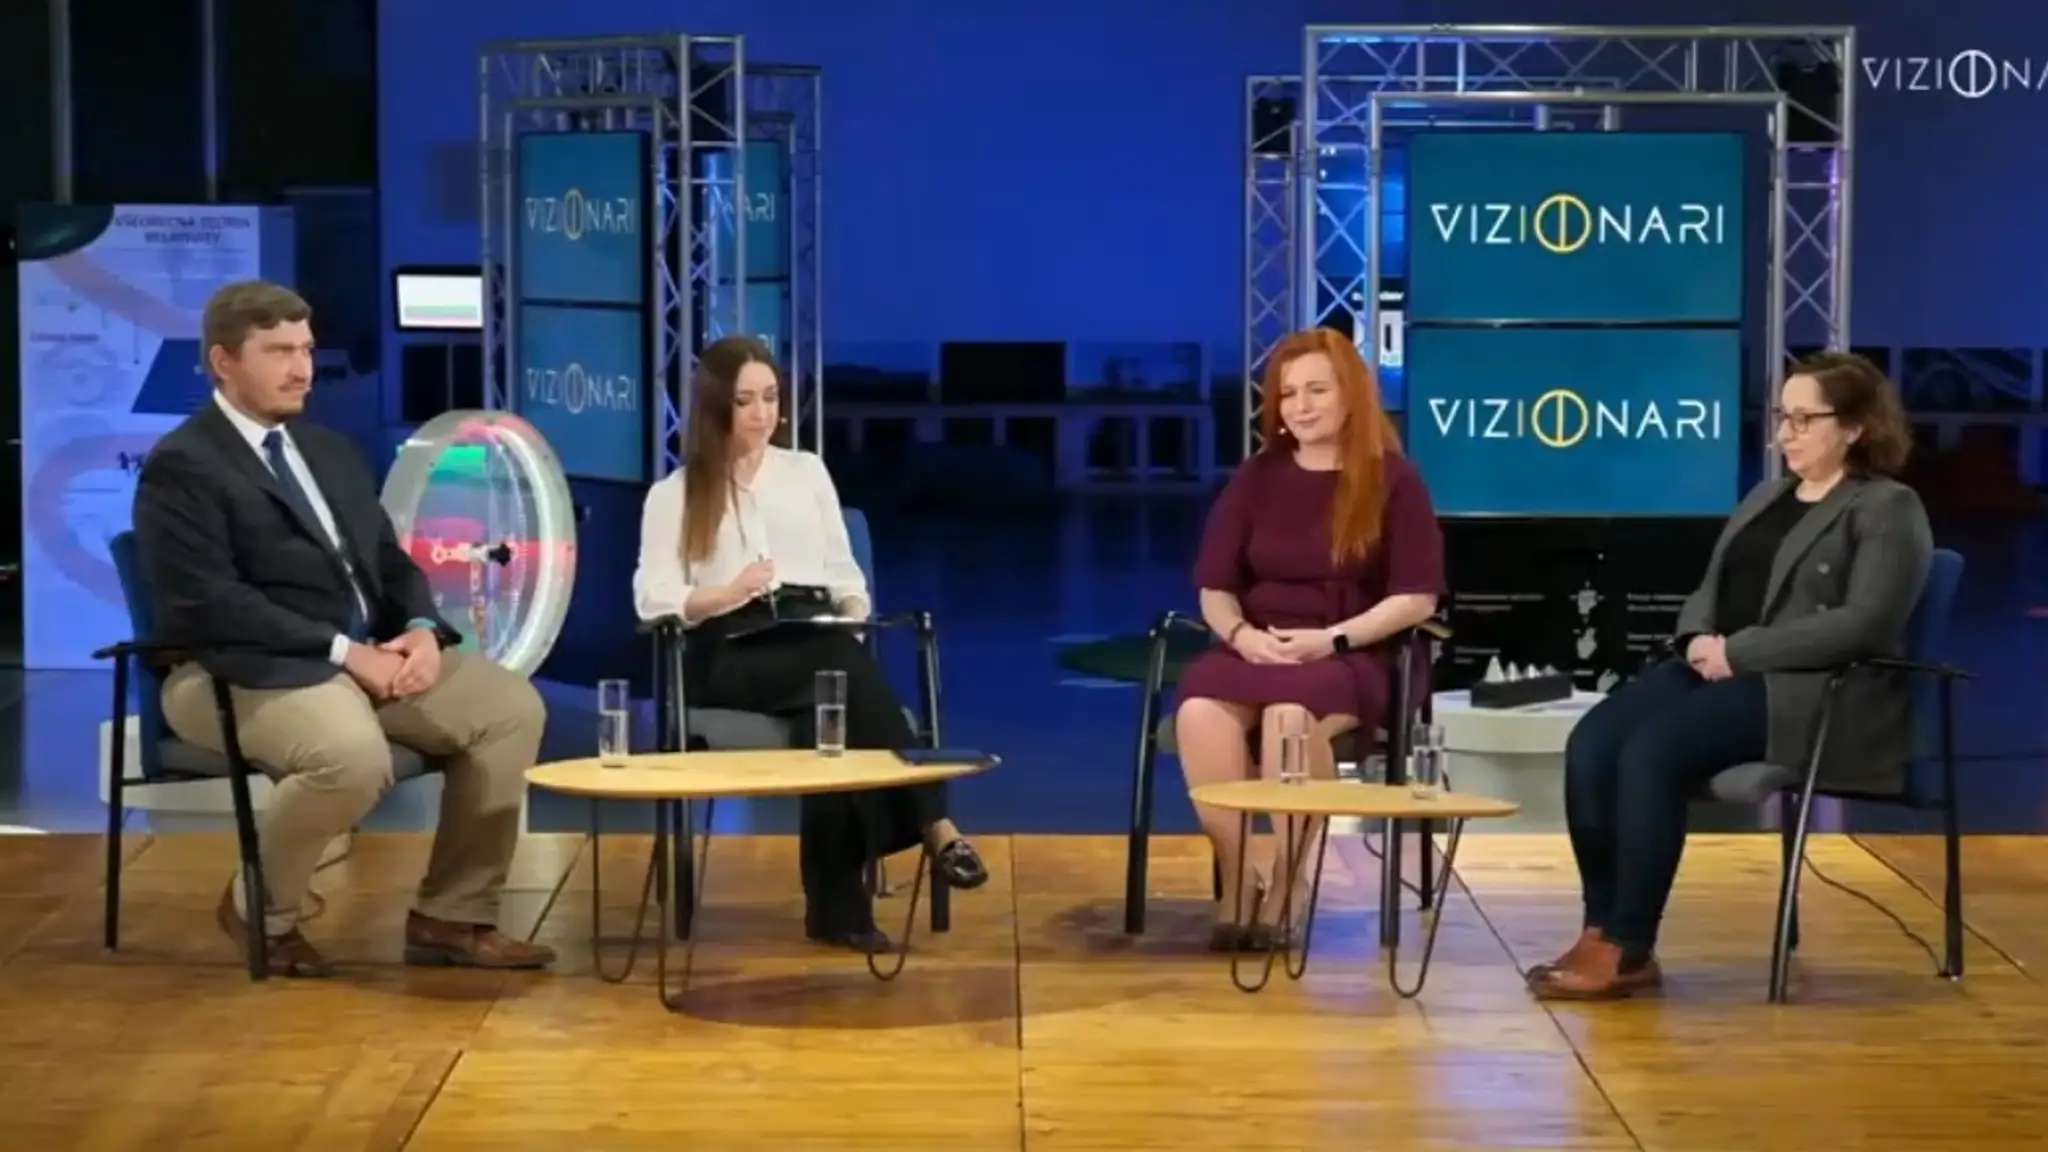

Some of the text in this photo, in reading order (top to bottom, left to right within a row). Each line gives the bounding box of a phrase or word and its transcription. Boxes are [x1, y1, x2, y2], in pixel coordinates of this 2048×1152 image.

[525, 188, 634, 240] VIZIONARI
[1431, 193, 1723, 253] VIZIONARI
[526, 362, 636, 414] VIZIONARI
[1429, 389, 1721, 448] VIZIONARI
